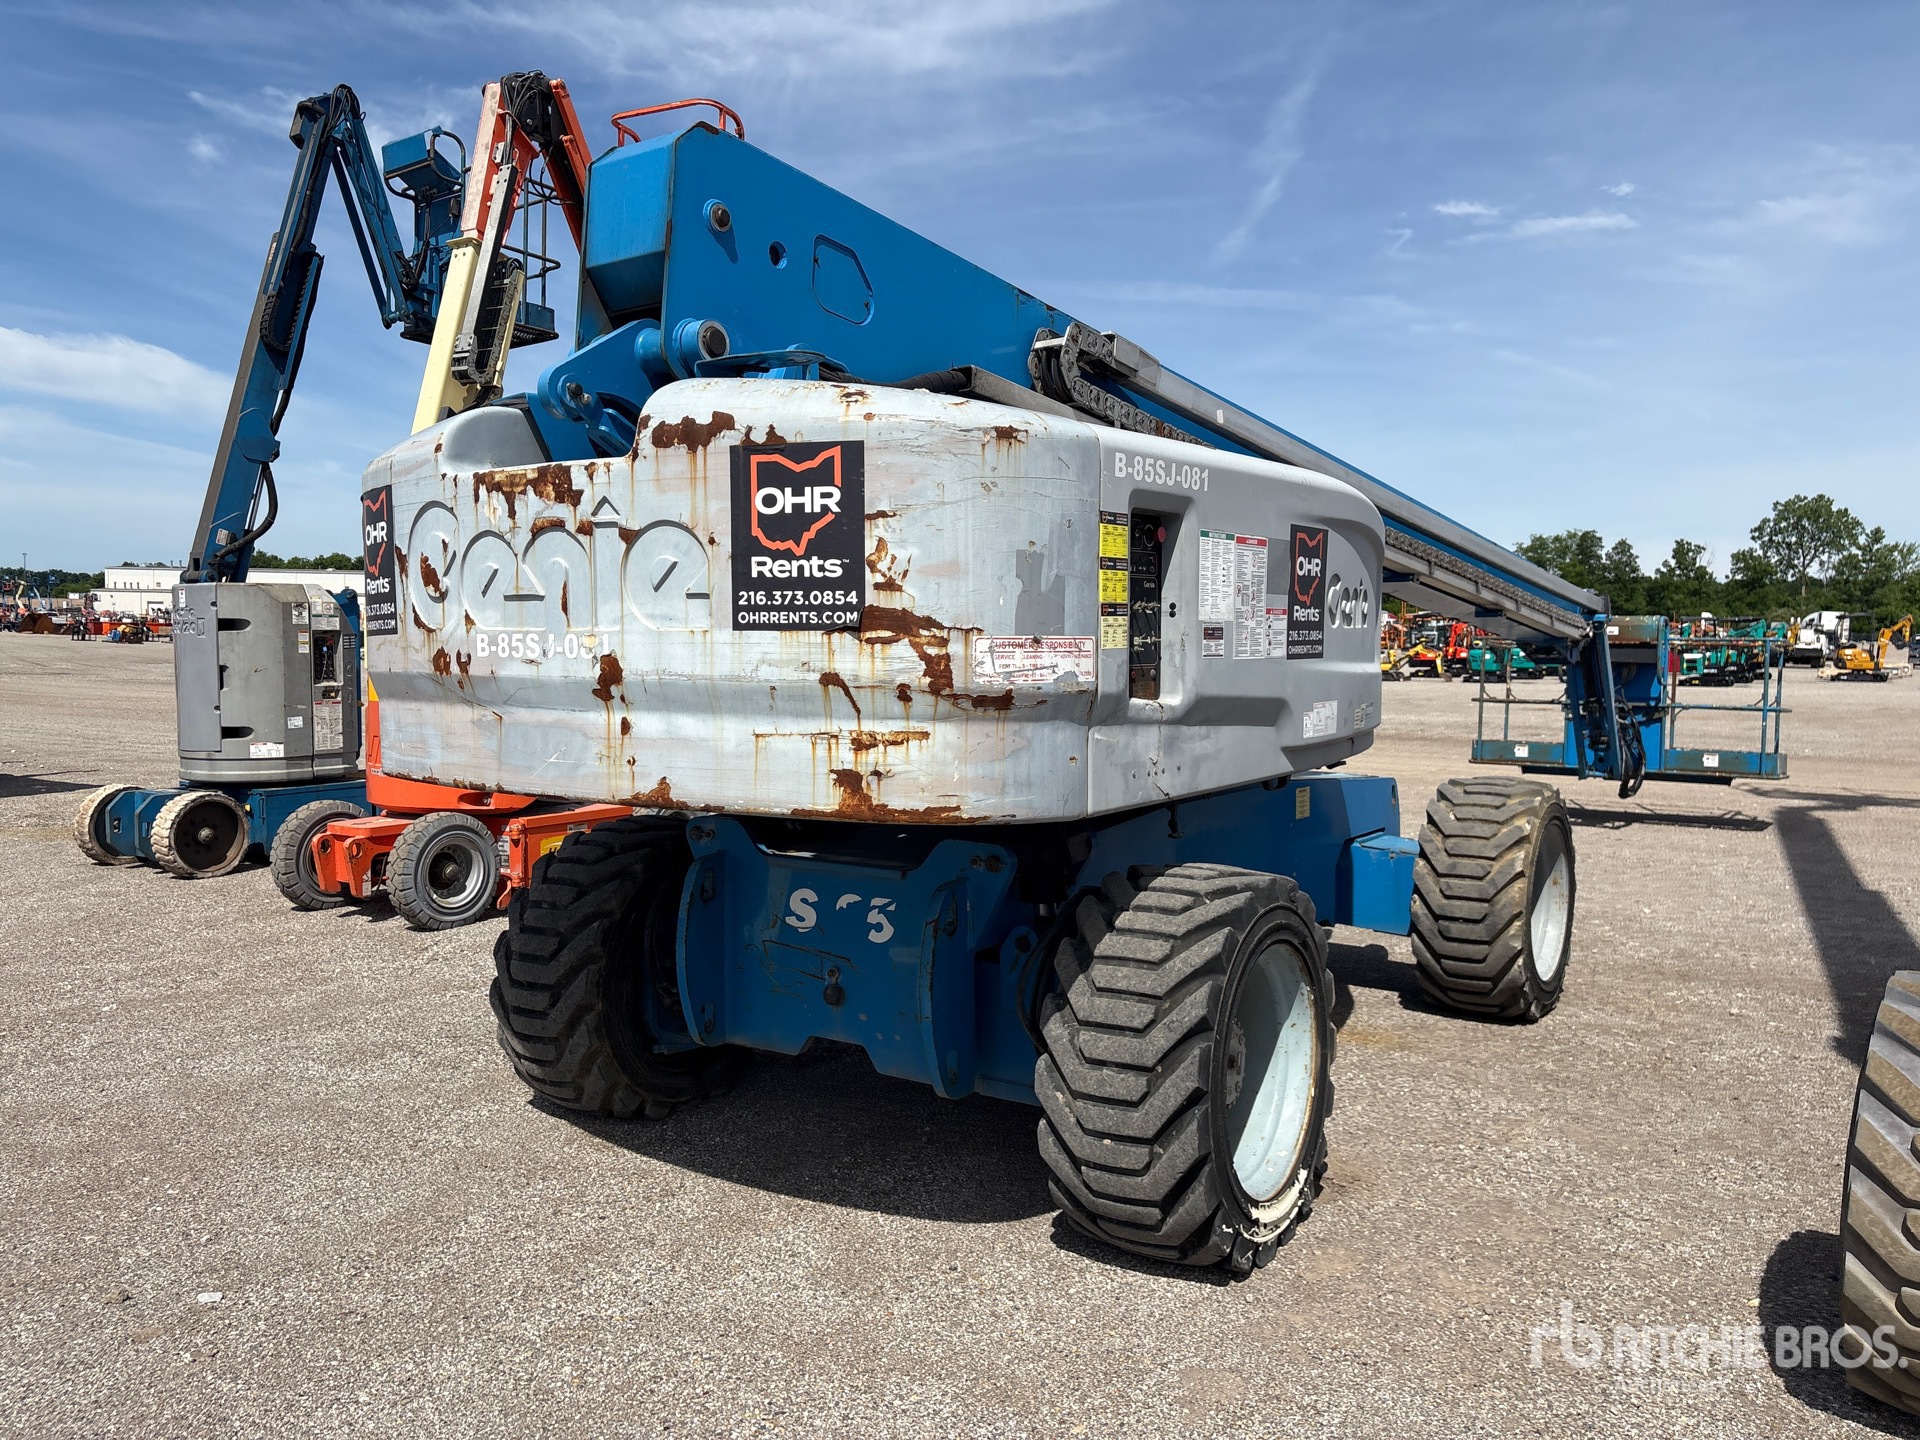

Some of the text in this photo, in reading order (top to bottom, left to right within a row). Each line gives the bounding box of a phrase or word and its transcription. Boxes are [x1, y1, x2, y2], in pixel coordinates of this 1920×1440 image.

[1114, 452, 1209, 491] B-85SJ-081
[755, 486, 841, 515] OHR
[365, 521, 387, 546] OHR
[407, 495, 711, 631] Genie
[1296, 556, 1321, 577] OHR
[738, 591, 858, 605] 216.373.0854
[1327, 573, 1368, 629] Genie
[366, 602, 395, 617] 6.373.0854
[738, 611, 857, 624] OHRRENTS.COM
[1288, 630, 1323, 641] 216.373.0854
[1288, 644, 1323, 655] OHRRENTS.COM
